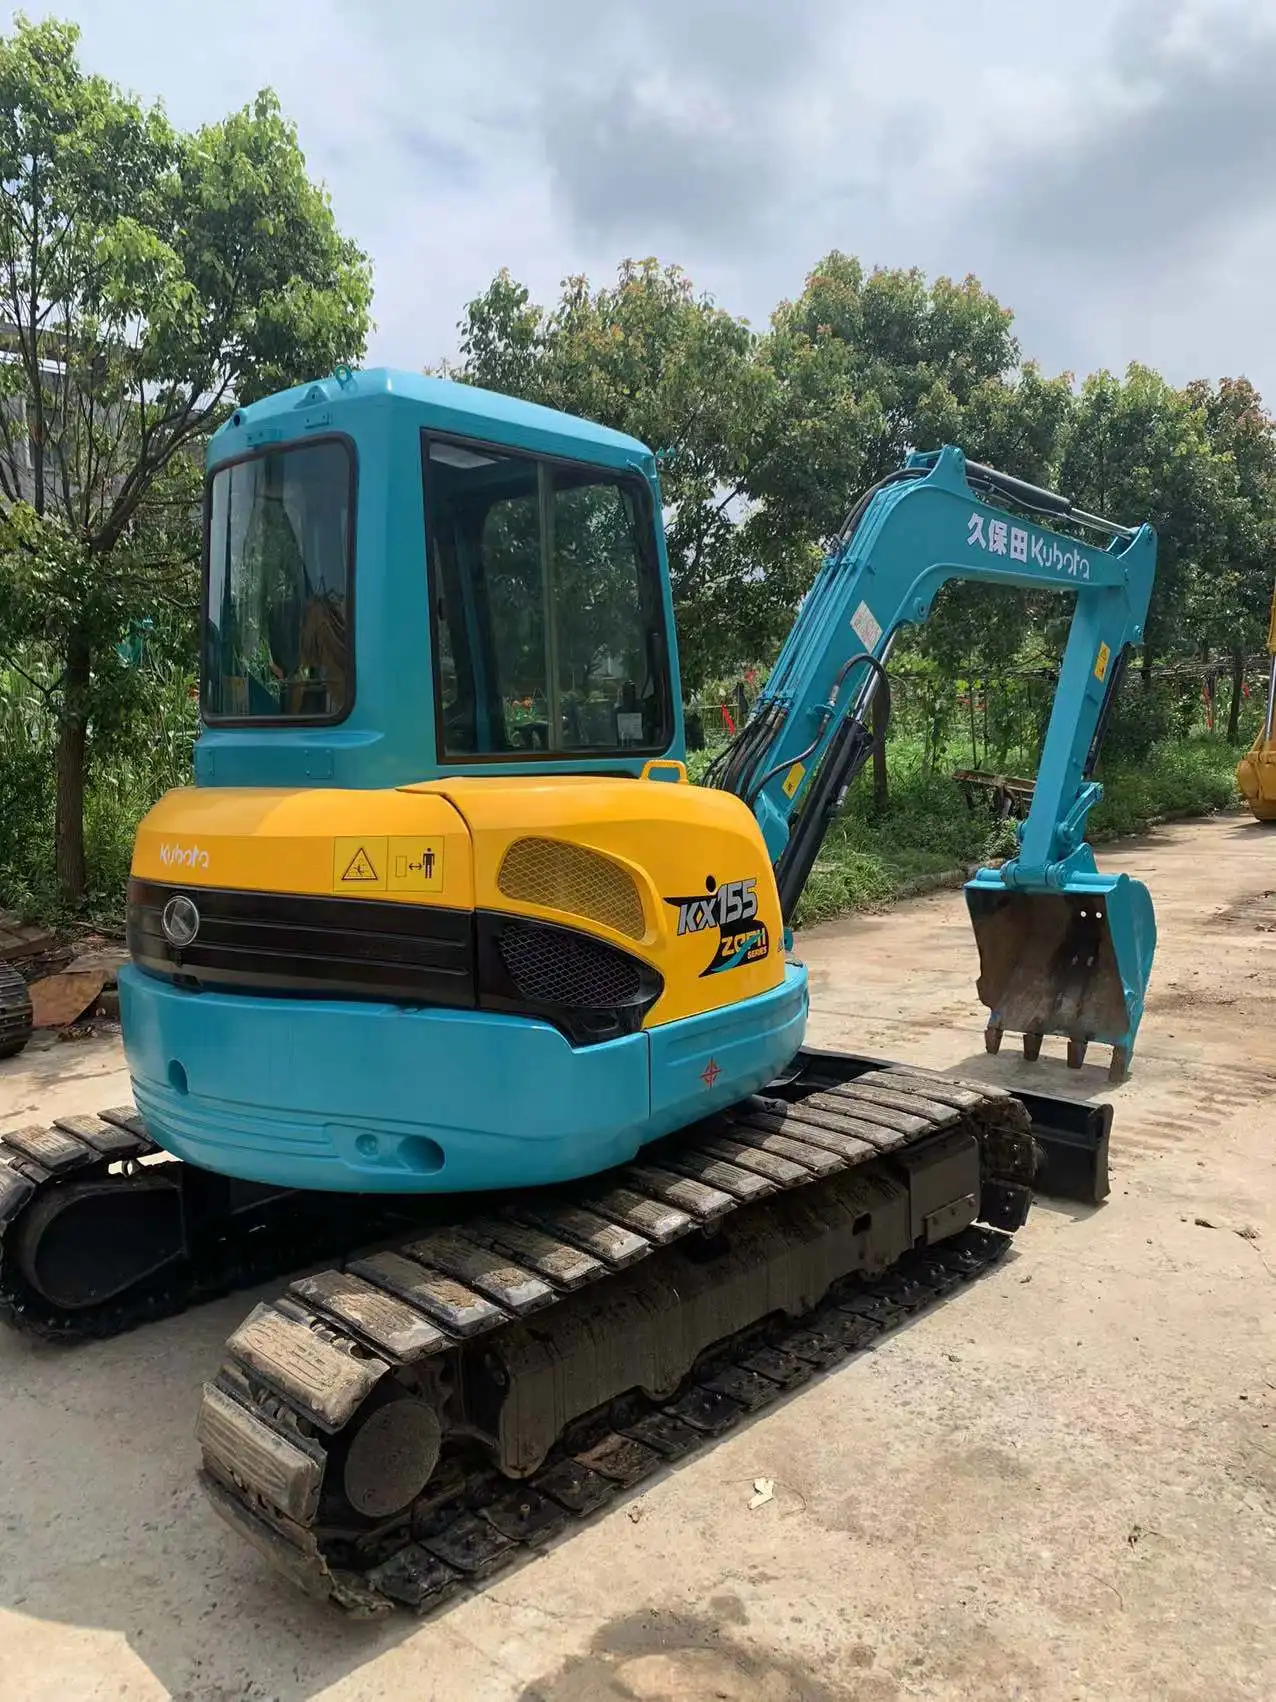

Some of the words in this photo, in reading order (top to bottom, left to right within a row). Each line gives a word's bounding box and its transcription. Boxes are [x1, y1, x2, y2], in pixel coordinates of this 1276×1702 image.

[967, 512, 1028, 563] 久保田
[1031, 535, 1090, 580] Kubota
[160, 843, 209, 869] Kubota
[677, 877, 758, 936] KX155
